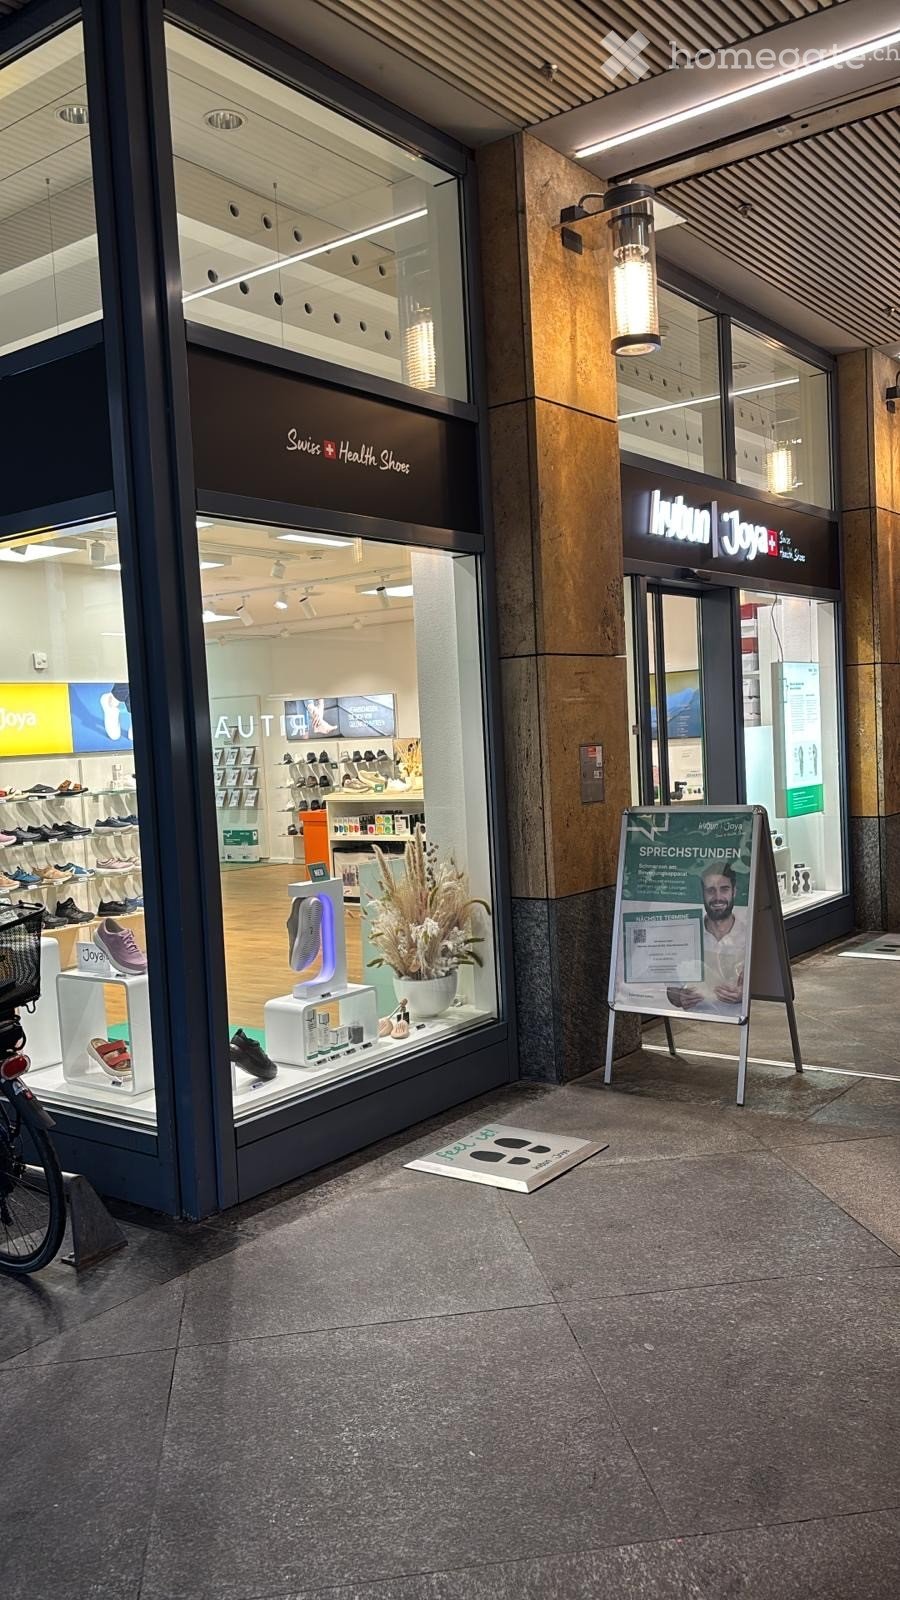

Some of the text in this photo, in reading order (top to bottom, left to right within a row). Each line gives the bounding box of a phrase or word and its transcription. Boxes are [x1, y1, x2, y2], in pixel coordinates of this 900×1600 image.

[286, 427, 411, 475] Swiss Health Shoes
[721, 509, 769, 561] Joya
[639, 846, 742, 858] SPRECHSTUNDEN
[82, 948, 104, 963] Joya
